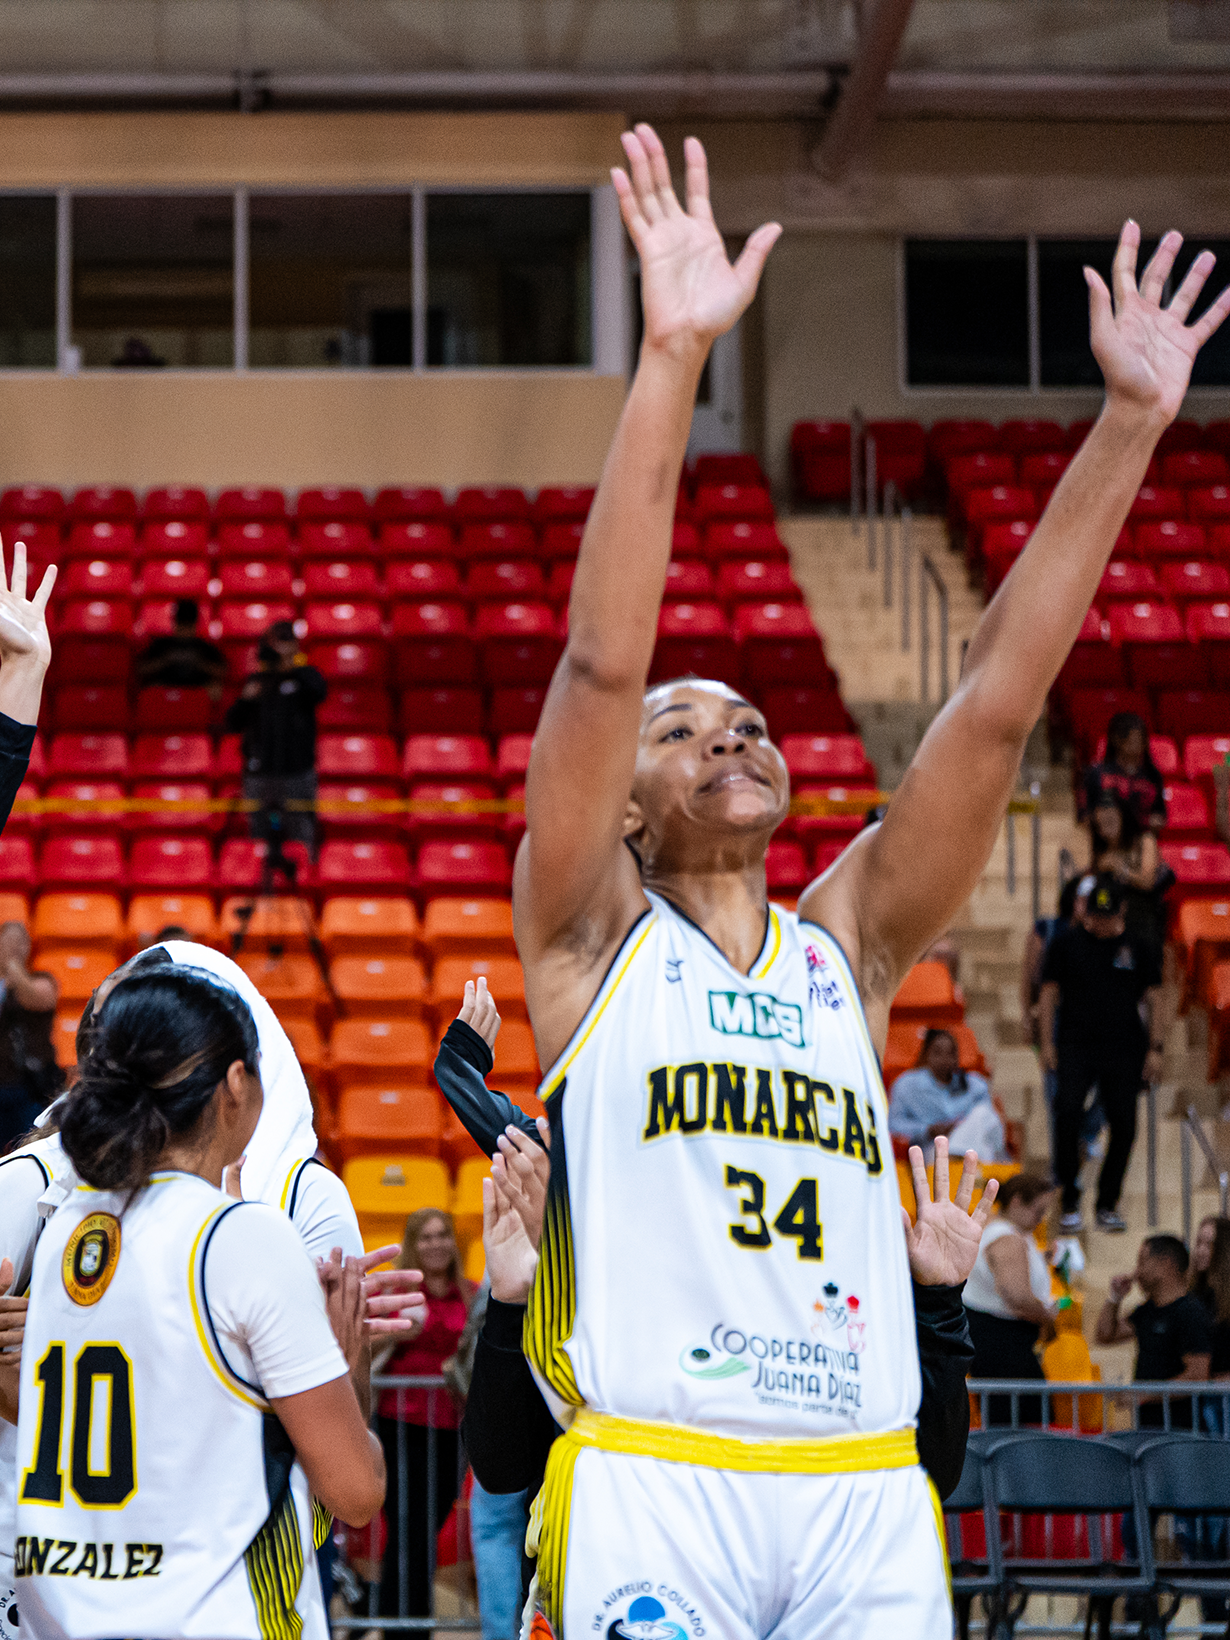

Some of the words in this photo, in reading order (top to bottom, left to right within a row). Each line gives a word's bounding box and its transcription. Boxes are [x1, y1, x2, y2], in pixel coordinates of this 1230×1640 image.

[708, 989, 806, 1050] MCS
[723, 1163, 824, 1264] 34
[710, 1322, 860, 1377] COOPERATIVA
[752, 1360, 821, 1399] JUANA
[18, 1340, 138, 1511] 10
[14, 1534, 164, 1580] ONZALEZ
[602, 1581, 652, 1610] AURELIO
[656, 1584, 706, 1637] COLLADO
